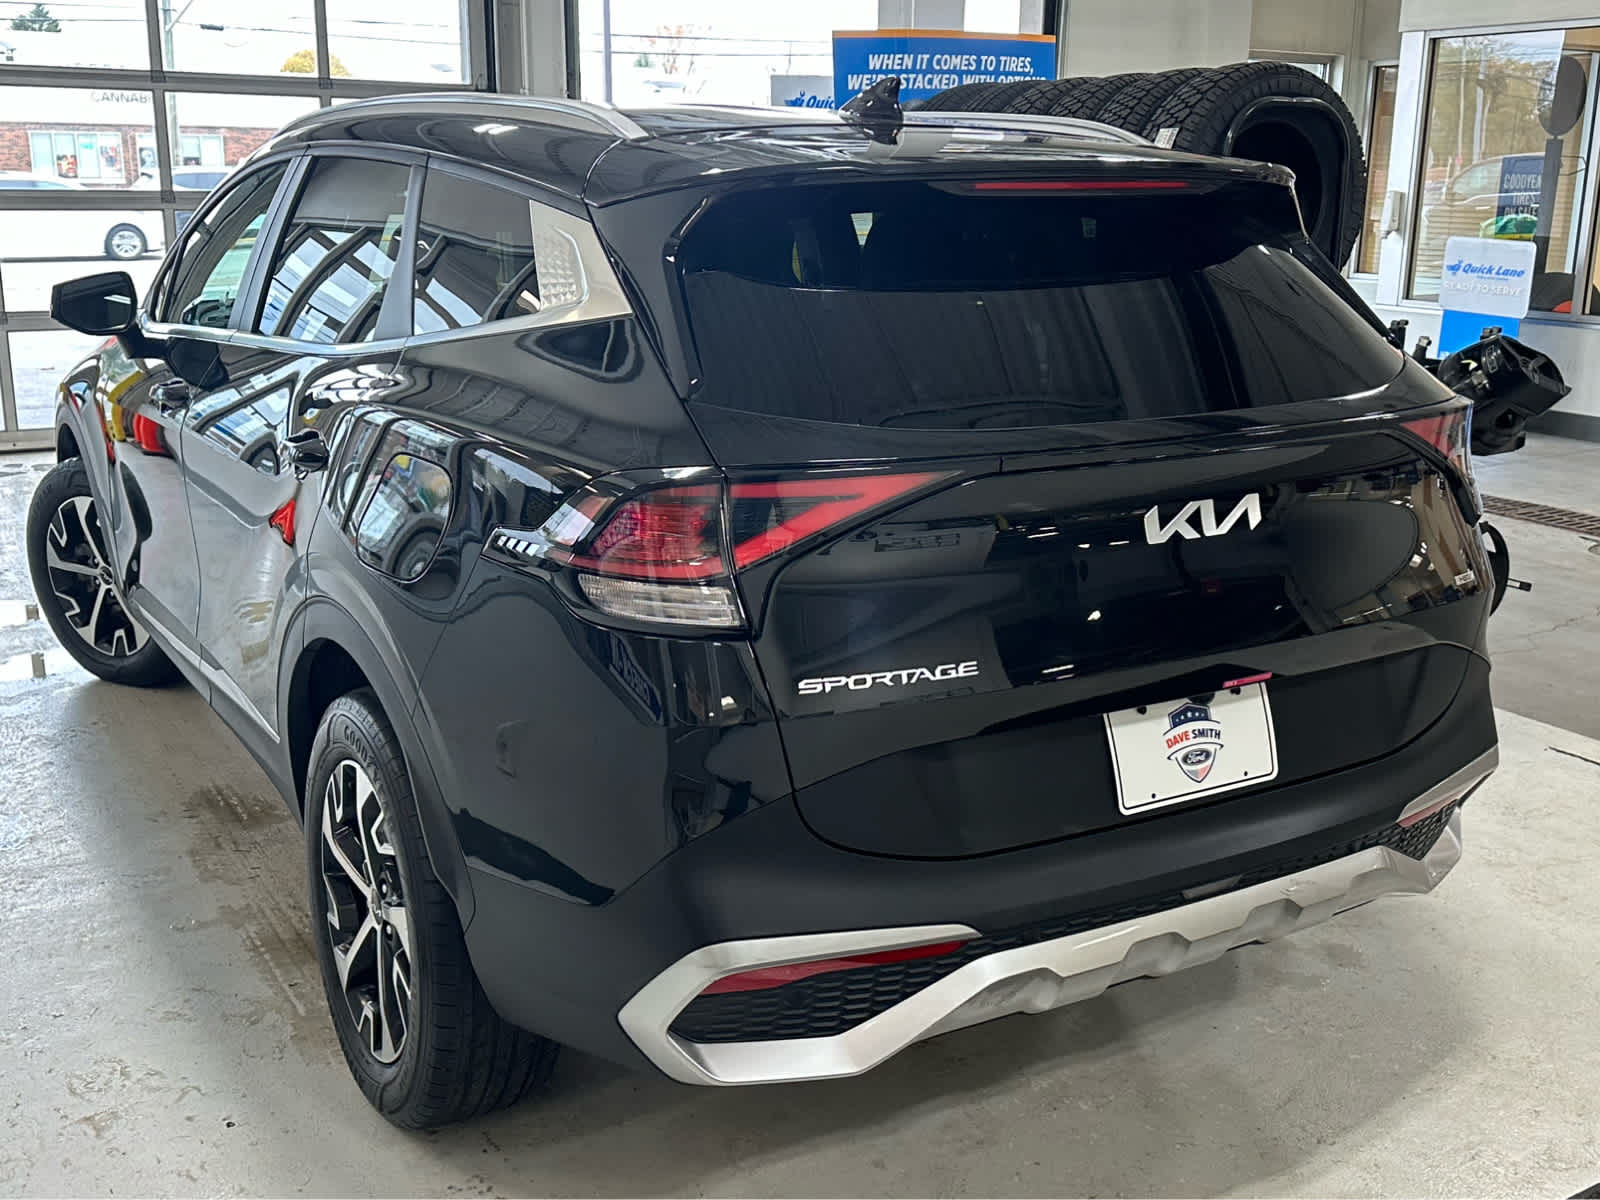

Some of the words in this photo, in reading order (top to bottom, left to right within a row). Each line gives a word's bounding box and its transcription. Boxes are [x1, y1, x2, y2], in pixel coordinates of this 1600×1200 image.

[868, 54, 914, 70] WHEN
[916, 54, 930, 70] IT
[932, 55, 977, 71] COMES
[980, 56, 996, 71] TO
[999, 56, 1034, 75] TIRES,
[899, 73, 959, 89] STACKED
[1462, 263, 1495, 274] Quick
[1495, 265, 1525, 277] Lane
[1144, 493, 1262, 544] KIA
[798, 661, 979, 695] SPORTAGE
[1165, 730, 1190, 749] DAVE
[1191, 728, 1221, 740] SMITH
